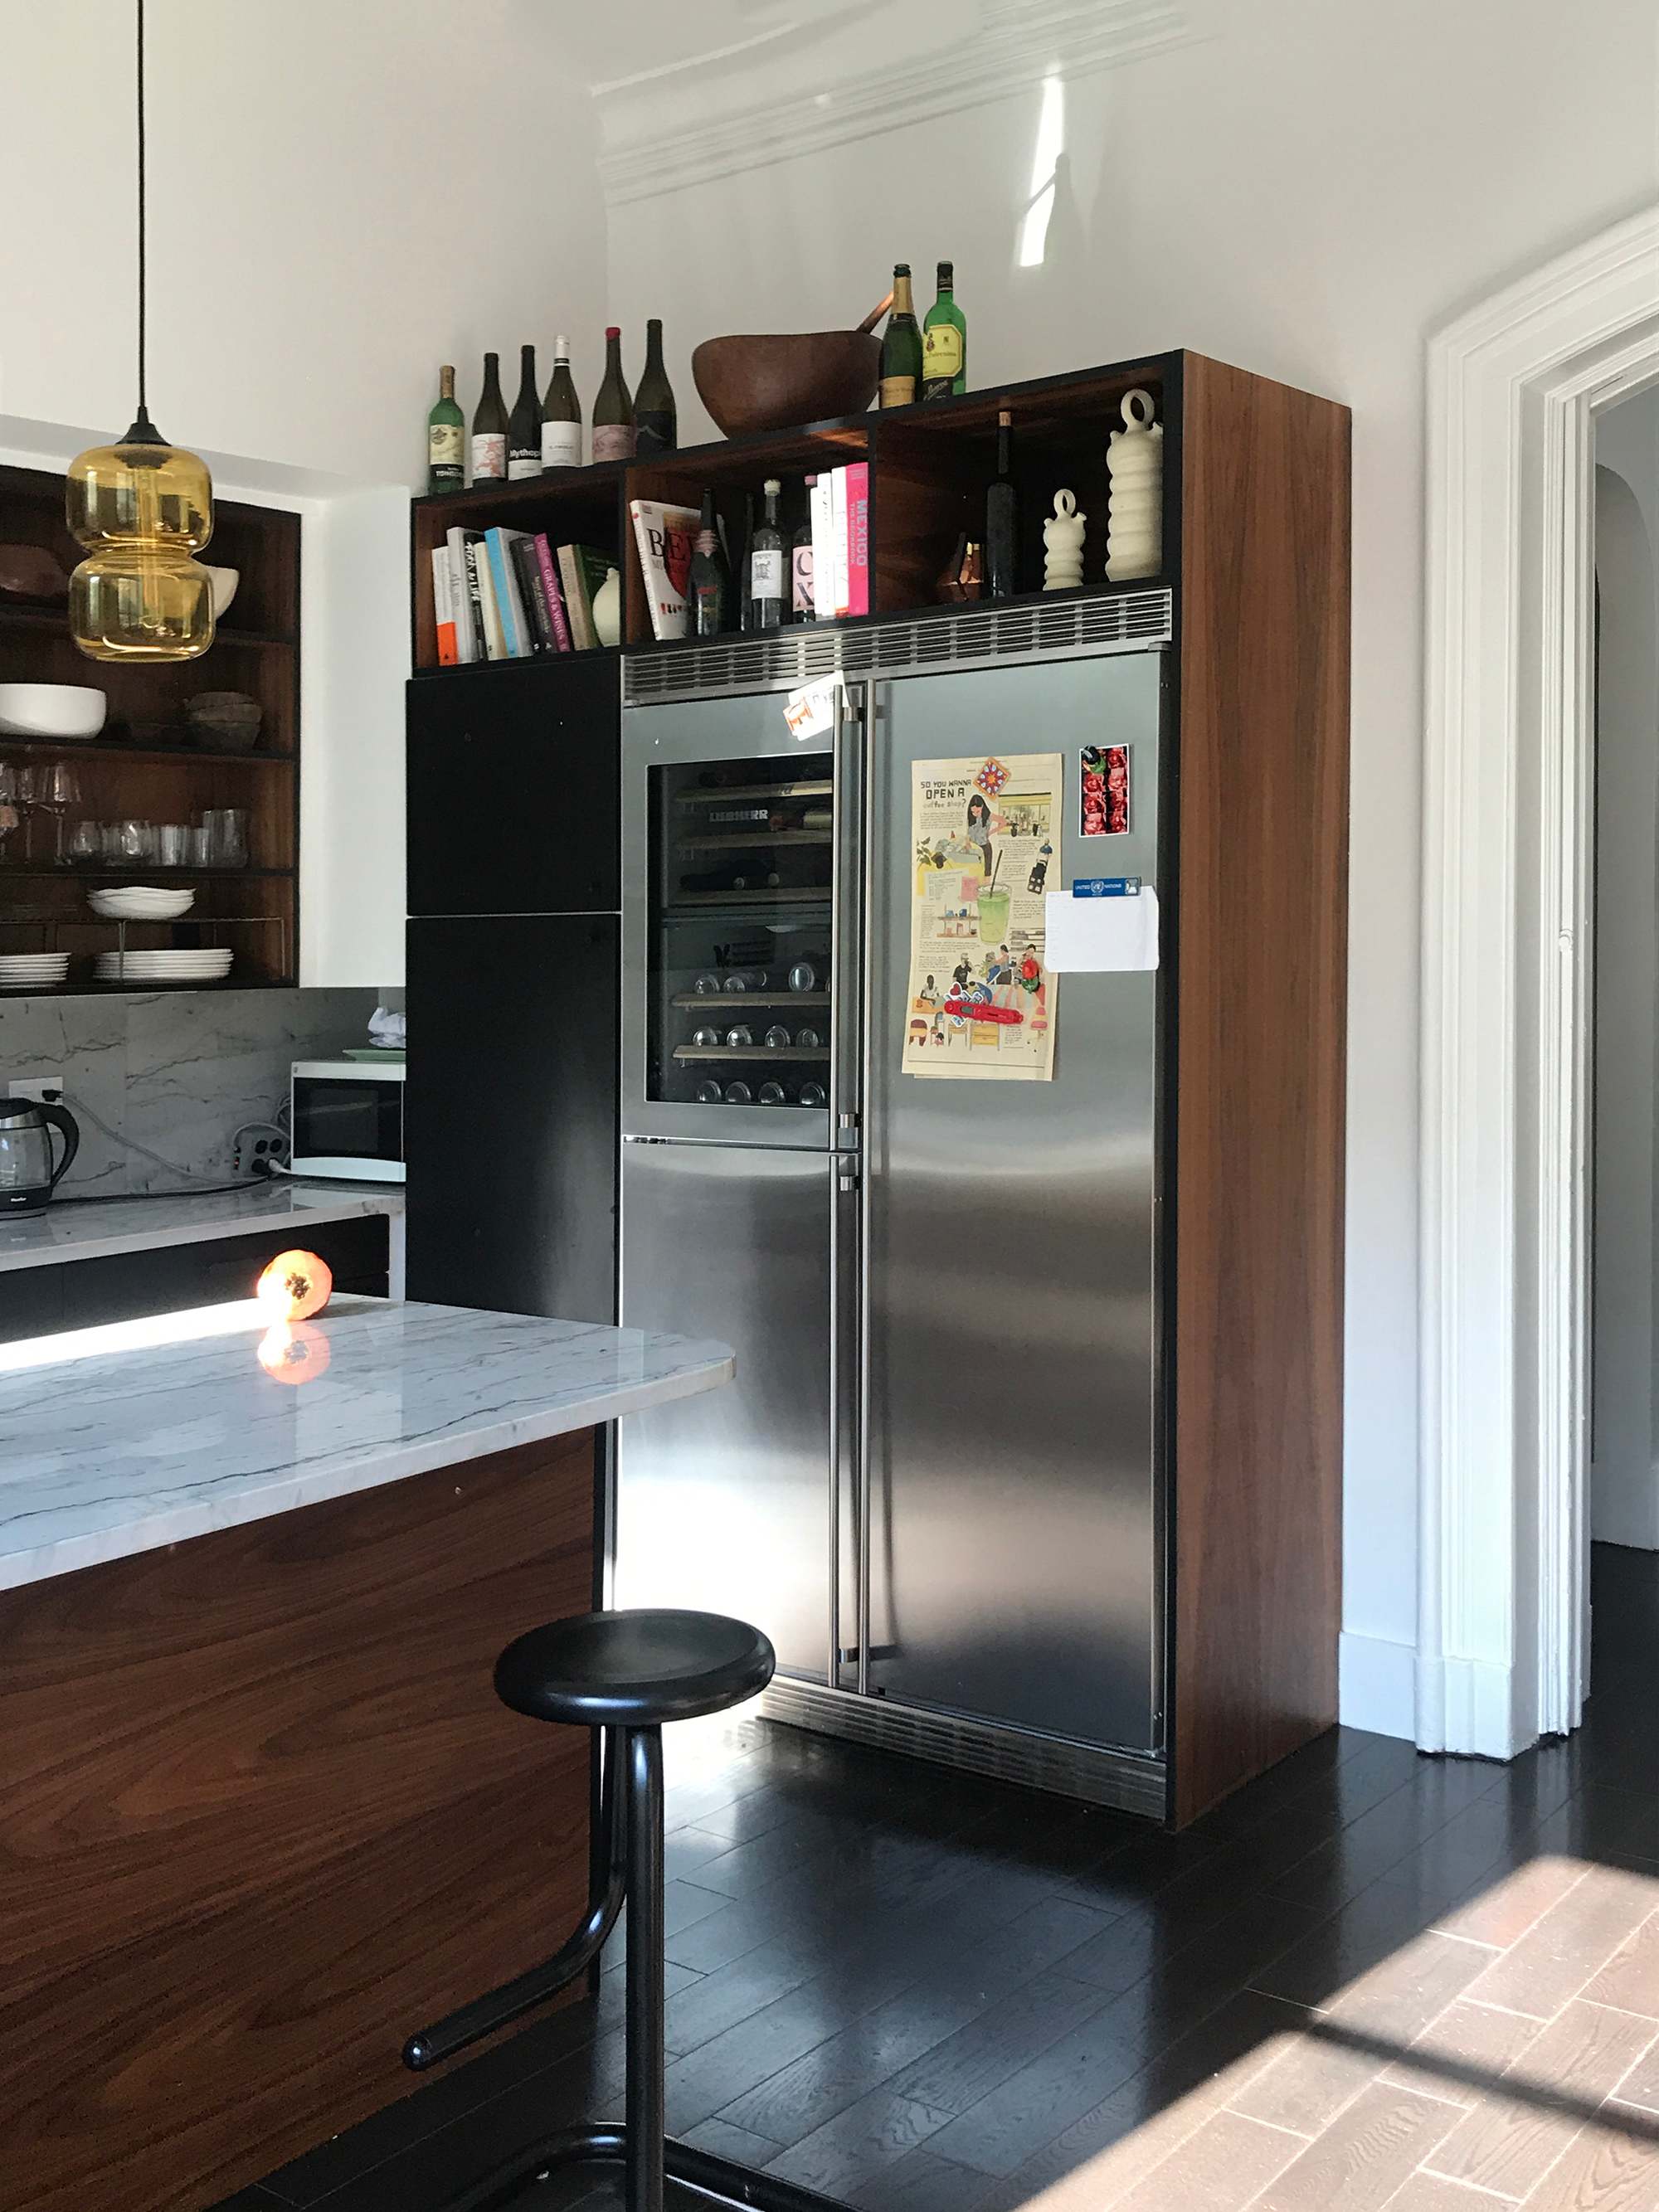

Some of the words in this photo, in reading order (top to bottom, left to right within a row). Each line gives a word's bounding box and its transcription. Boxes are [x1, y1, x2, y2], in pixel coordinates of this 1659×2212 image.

[857, 499, 868, 566] MEXICO
[933, 780, 946, 789] YOU
[948, 779, 971, 787] WANNA
[926, 789, 955, 800] OPEN
[957, 787, 965, 797] A
